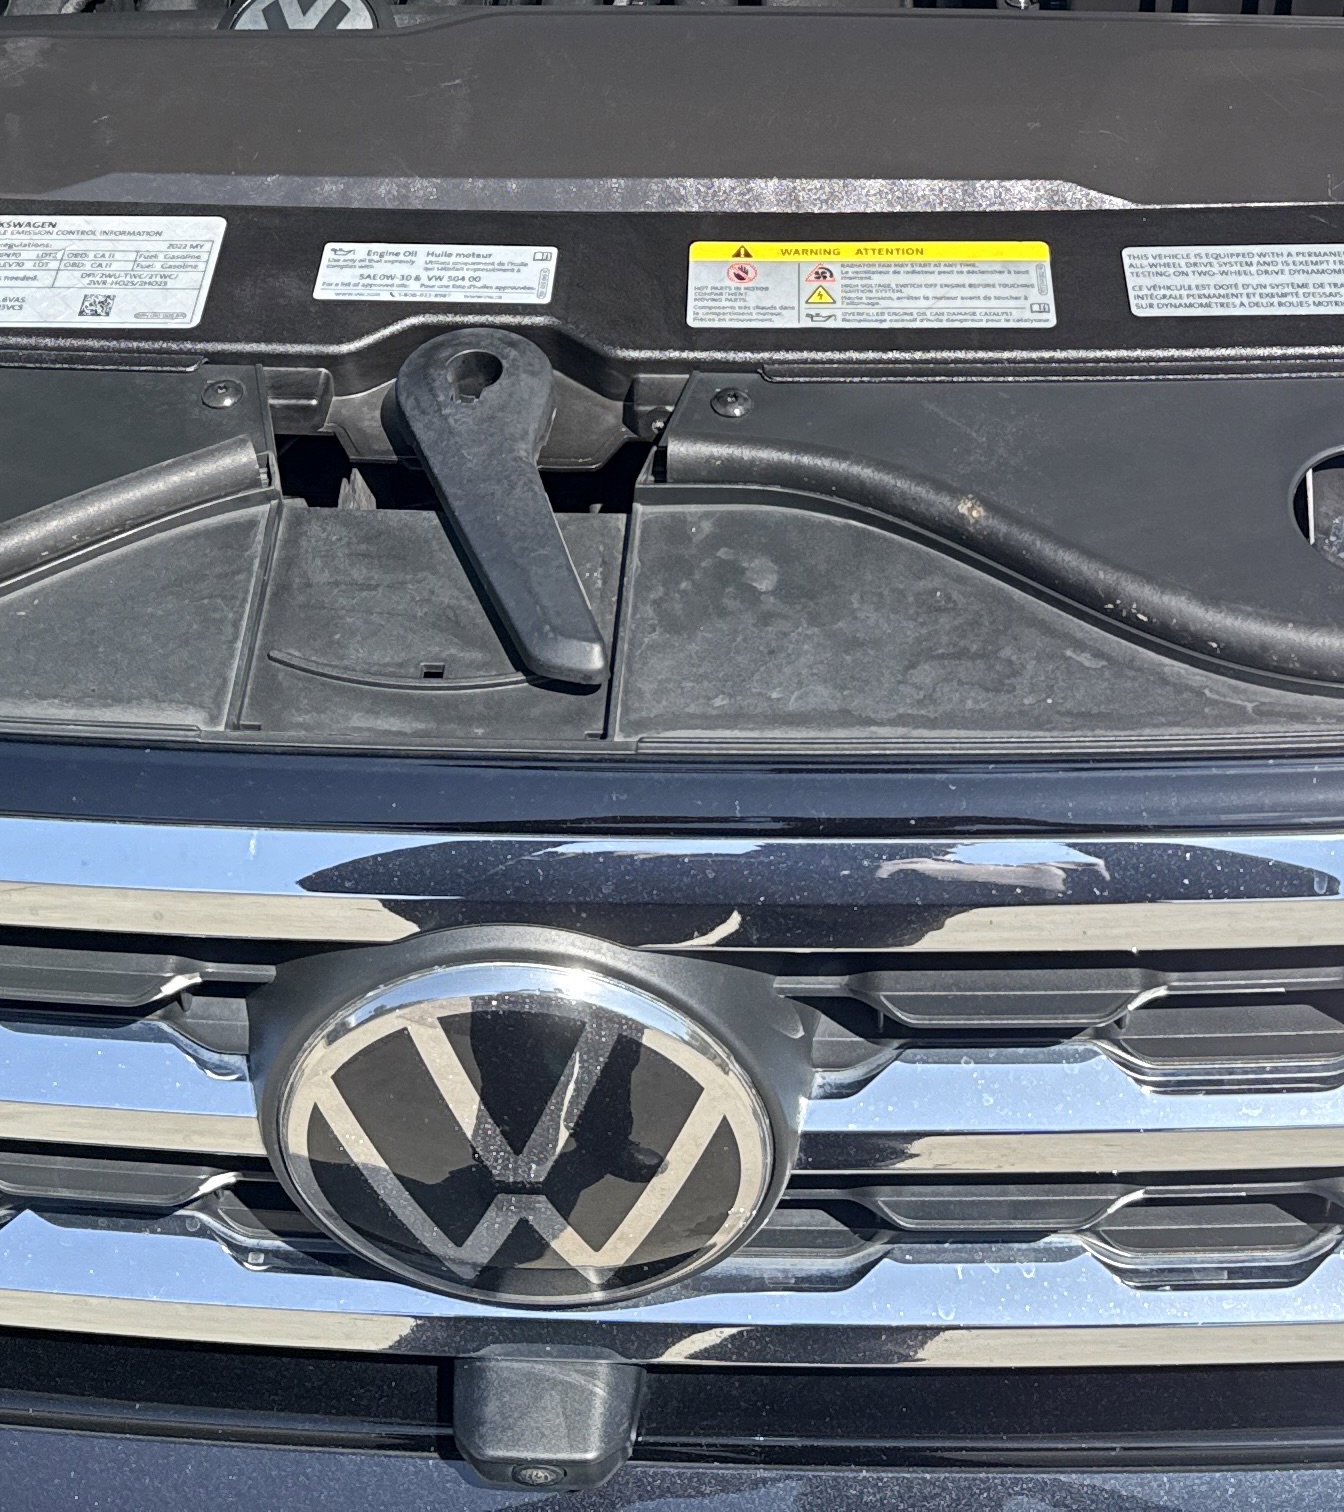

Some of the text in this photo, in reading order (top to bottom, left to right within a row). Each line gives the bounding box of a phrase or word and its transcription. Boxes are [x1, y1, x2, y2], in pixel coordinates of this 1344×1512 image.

[366, 250, 493, 259] Engine Oil Huile moteur
[780, 248, 925, 256] WARNING ATTENTION
[1127, 253, 1149, 261] THIS
[1150, 252, 1191, 260] VEHICLE
[1194, 252, 1204, 260] IS
[1205, 251, 1255, 260] EQUIPPED
[1256, 251, 1284, 259] WITH
[1128, 261, 1183, 269] ALL-WHEEL
[1217, 260, 1254, 268] SYSTEM
[1292, 259, 1331, 267] EXEMPT
[426, 274, 444, 282] VW
[1130, 270, 1172, 278] TESTING
[1191, 269, 1255, 277] TWO-WHEEL
[1256, 268, 1286, 276] DRIVE
[1145, 283, 1193, 292] VÉHICULE
[1213, 282, 1239, 291] DOTÉ
[1133, 292, 1184, 300] INTÉGRALE
[1186, 292, 1244, 300] PERMANENT
[1134, 302, 1155, 310] SUR
[1156, 300, 1237, 309] DYNAMOMÈTRES
